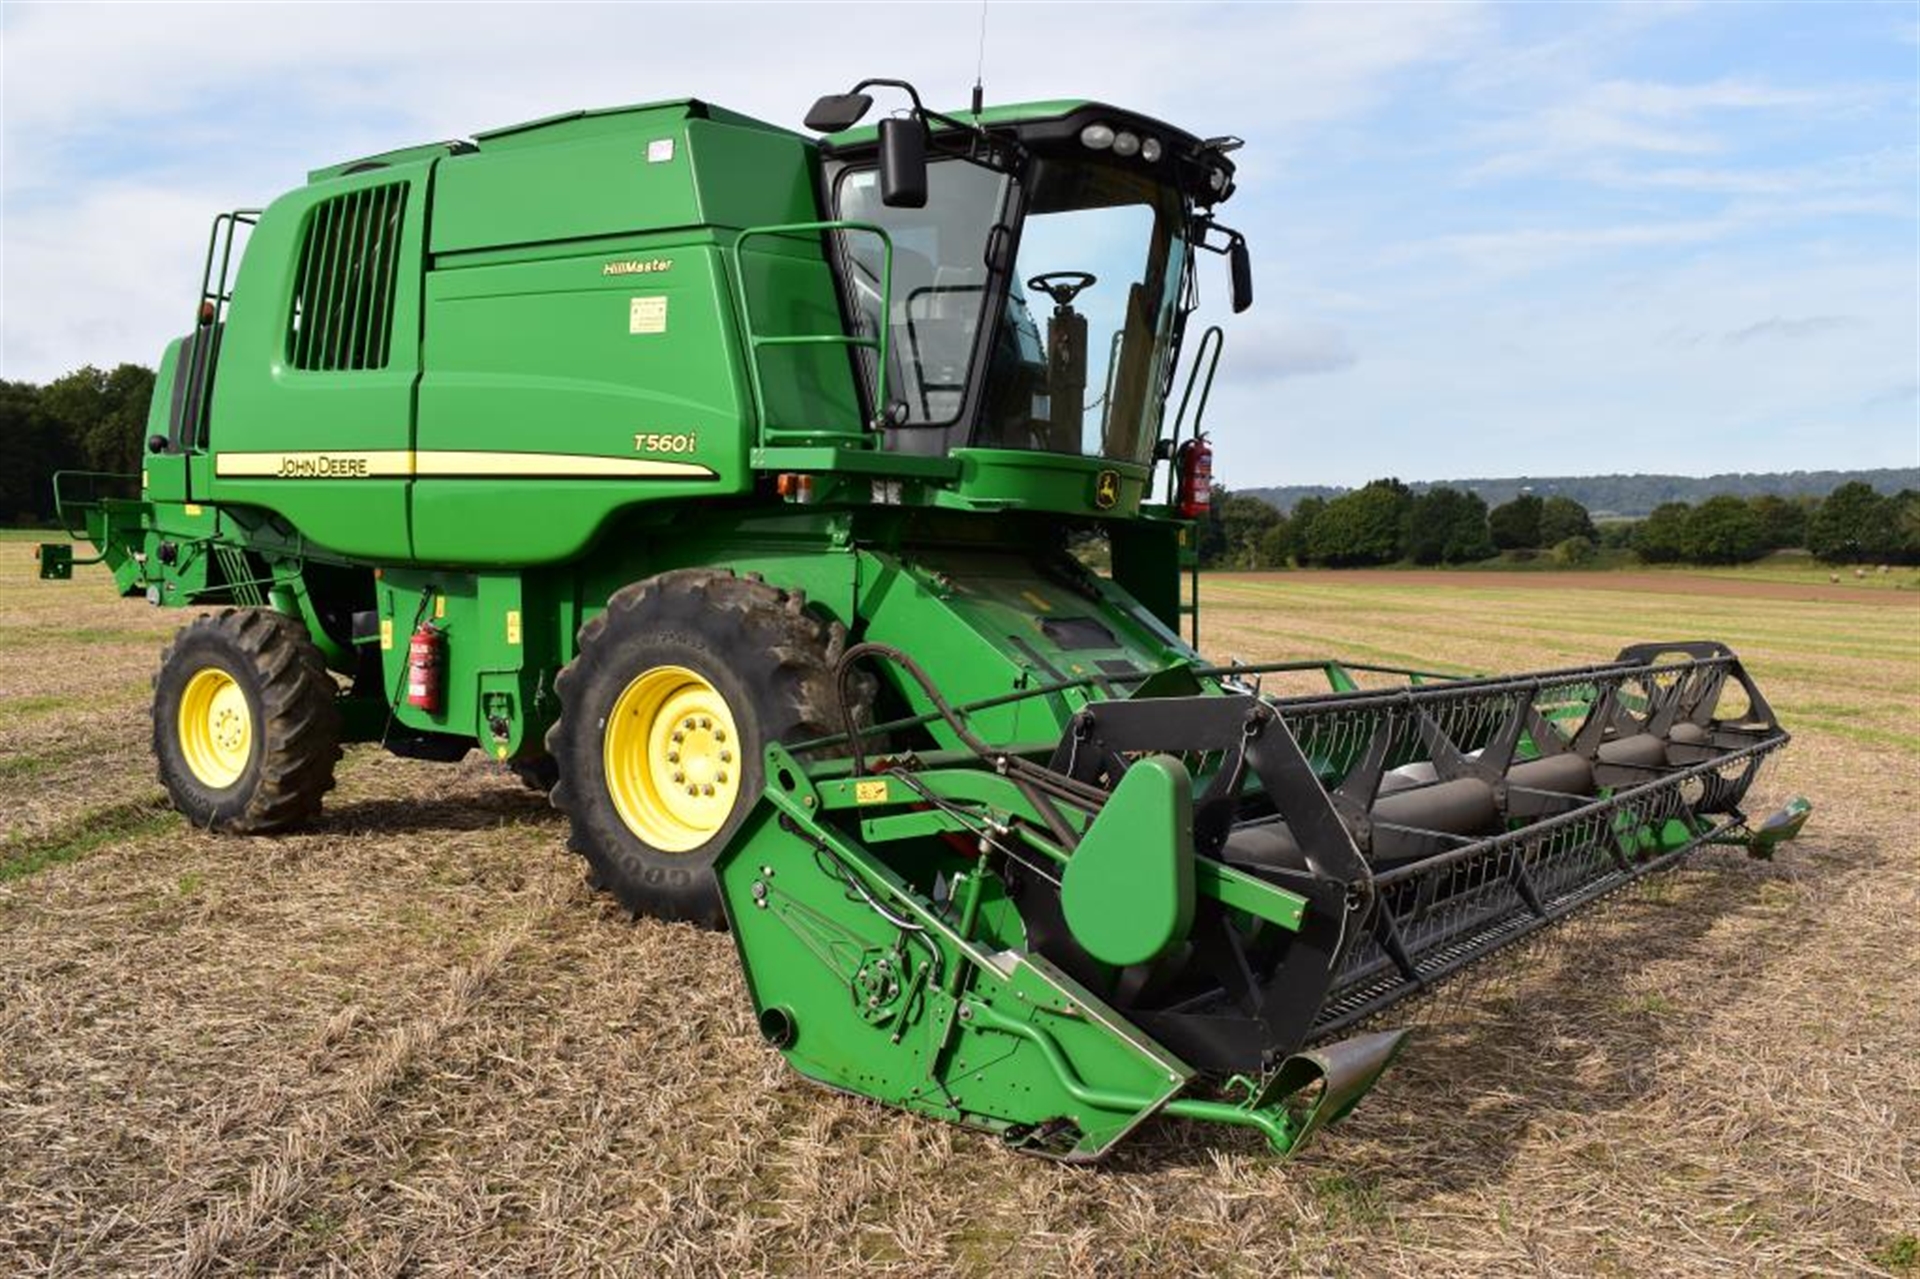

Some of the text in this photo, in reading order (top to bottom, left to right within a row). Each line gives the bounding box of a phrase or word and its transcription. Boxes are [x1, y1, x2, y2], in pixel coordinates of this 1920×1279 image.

[634, 431, 696, 453] T560i
[278, 456, 368, 475] JOHN DEERE
